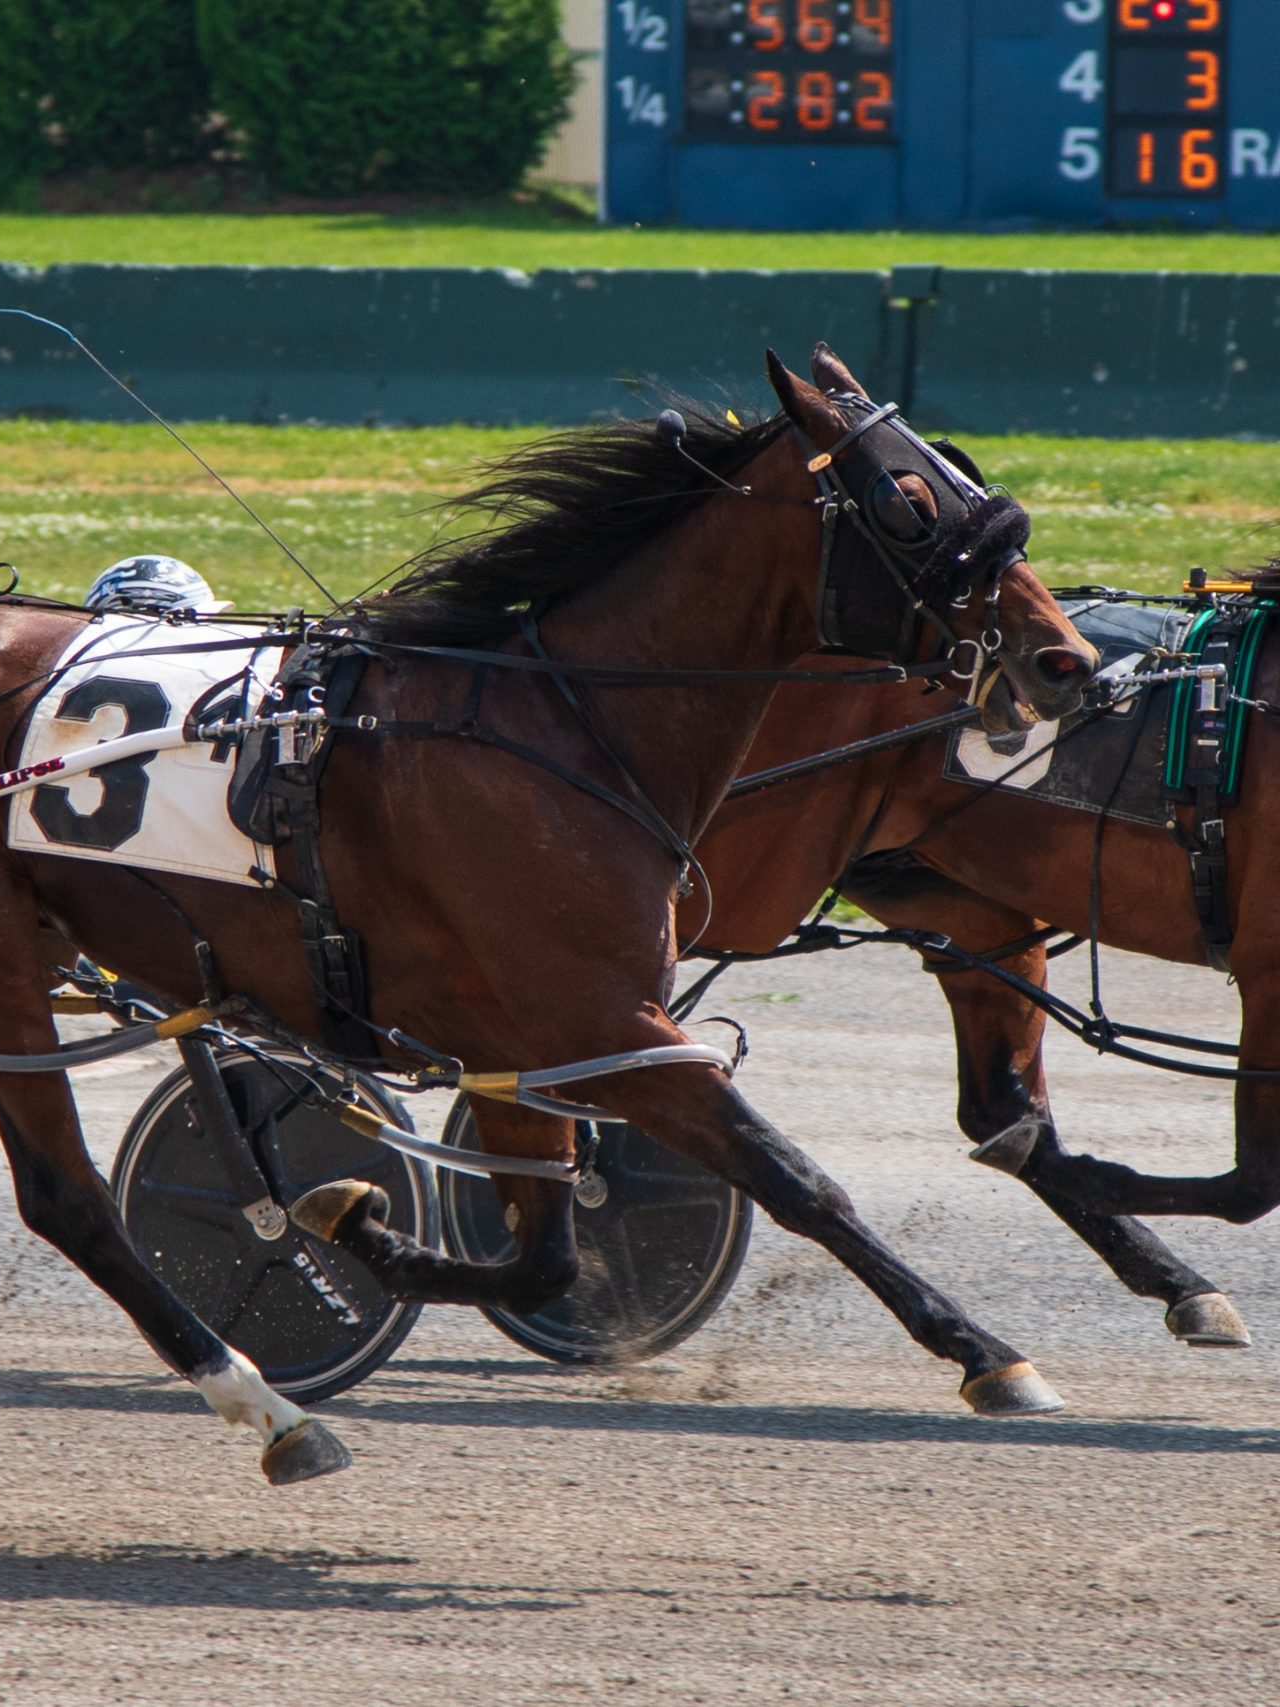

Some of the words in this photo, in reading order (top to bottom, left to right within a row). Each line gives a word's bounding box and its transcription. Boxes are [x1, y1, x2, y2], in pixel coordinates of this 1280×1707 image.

[1059, 50, 1104, 102] 4
[1185, 50, 1219, 110] 3
[1059, 126, 1101, 181] 5
[1138, 128, 1218, 189] 16
[1230, 127, 1280, 177] R
[30, 675, 172, 851] 3
